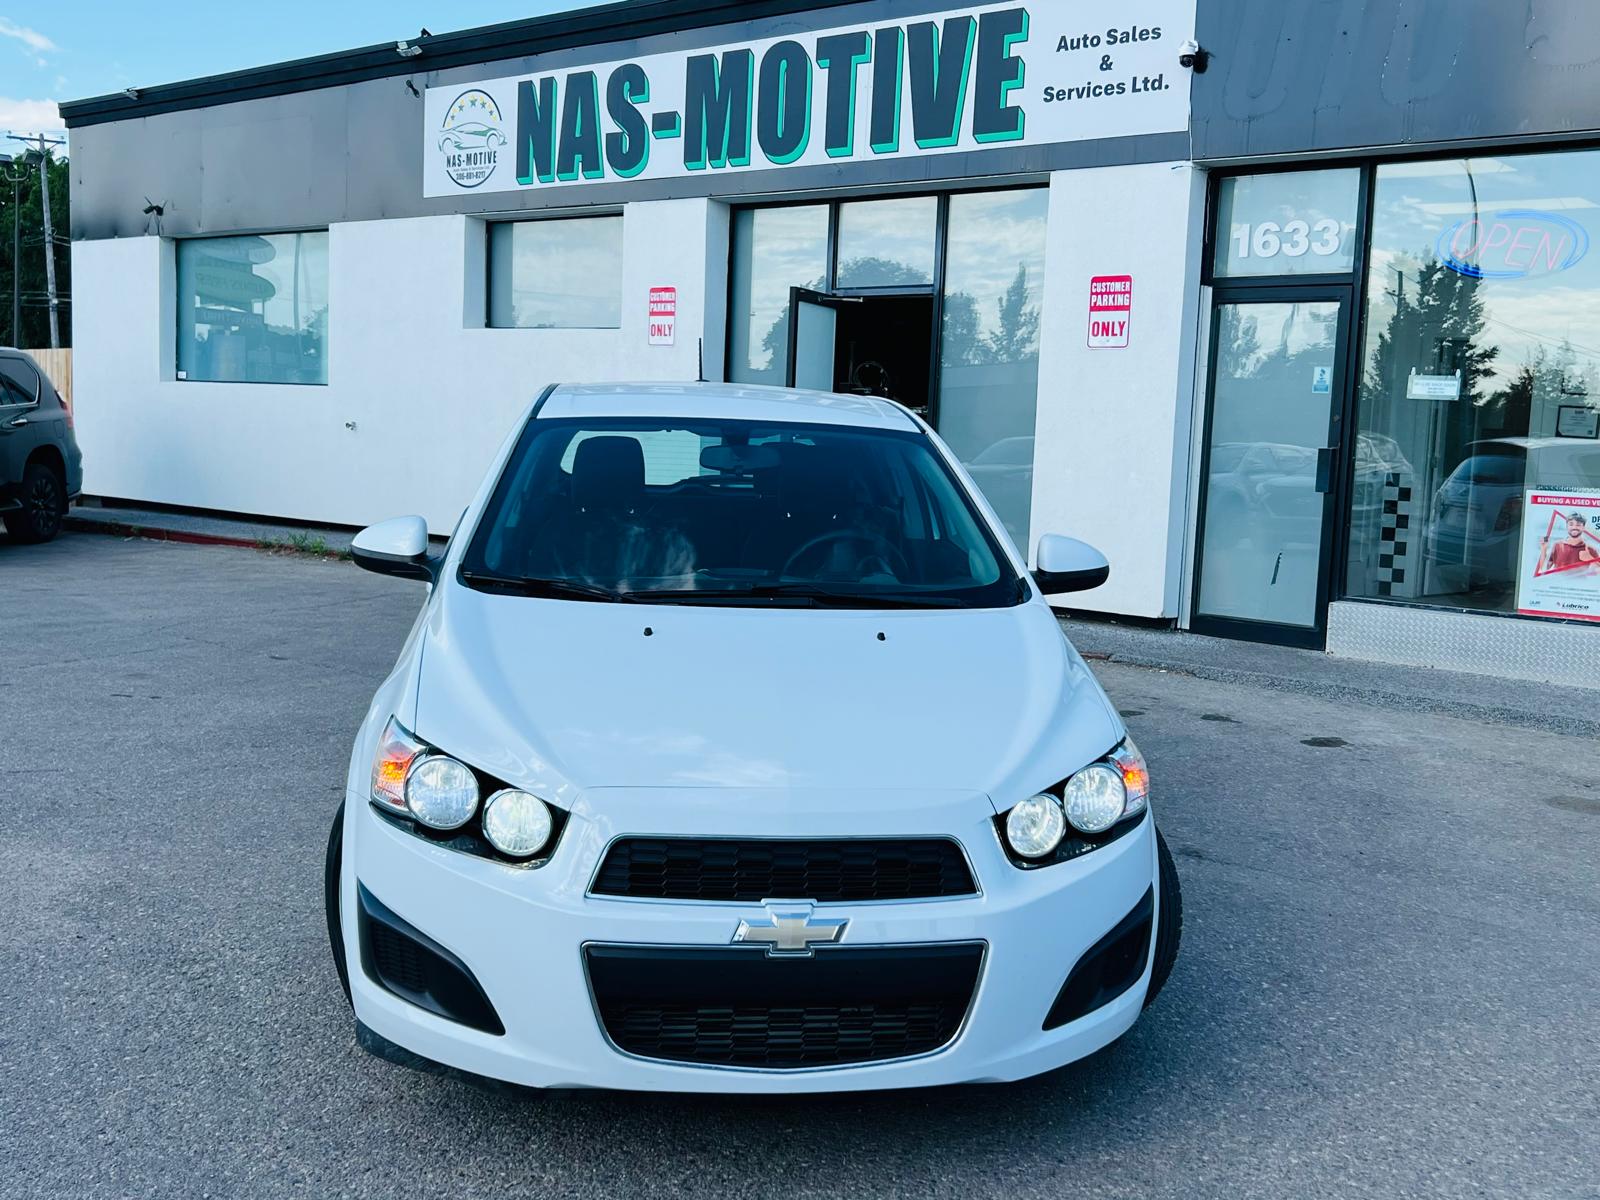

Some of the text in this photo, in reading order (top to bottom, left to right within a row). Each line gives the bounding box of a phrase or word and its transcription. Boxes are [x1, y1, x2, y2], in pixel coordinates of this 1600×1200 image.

[1056, 26, 1162, 52] Auto Sales
[1099, 54, 1114, 72] &
[516, 7, 1029, 185] NAS-MOTIVE
[1043, 73, 1170, 103] Services Ltd.
[446, 151, 497, 168] NAS-MOTIVE
[1232, 218, 1340, 258] 1633
[1452, 219, 1568, 271] OPEN
[1091, 281, 1131, 293] CUSTOMER
[1091, 294, 1130, 307] PARKING
[650, 323, 673, 337] ONLY
[1091, 321, 1126, 337] ONLY
[1537, 496, 1564, 504] BUYING
